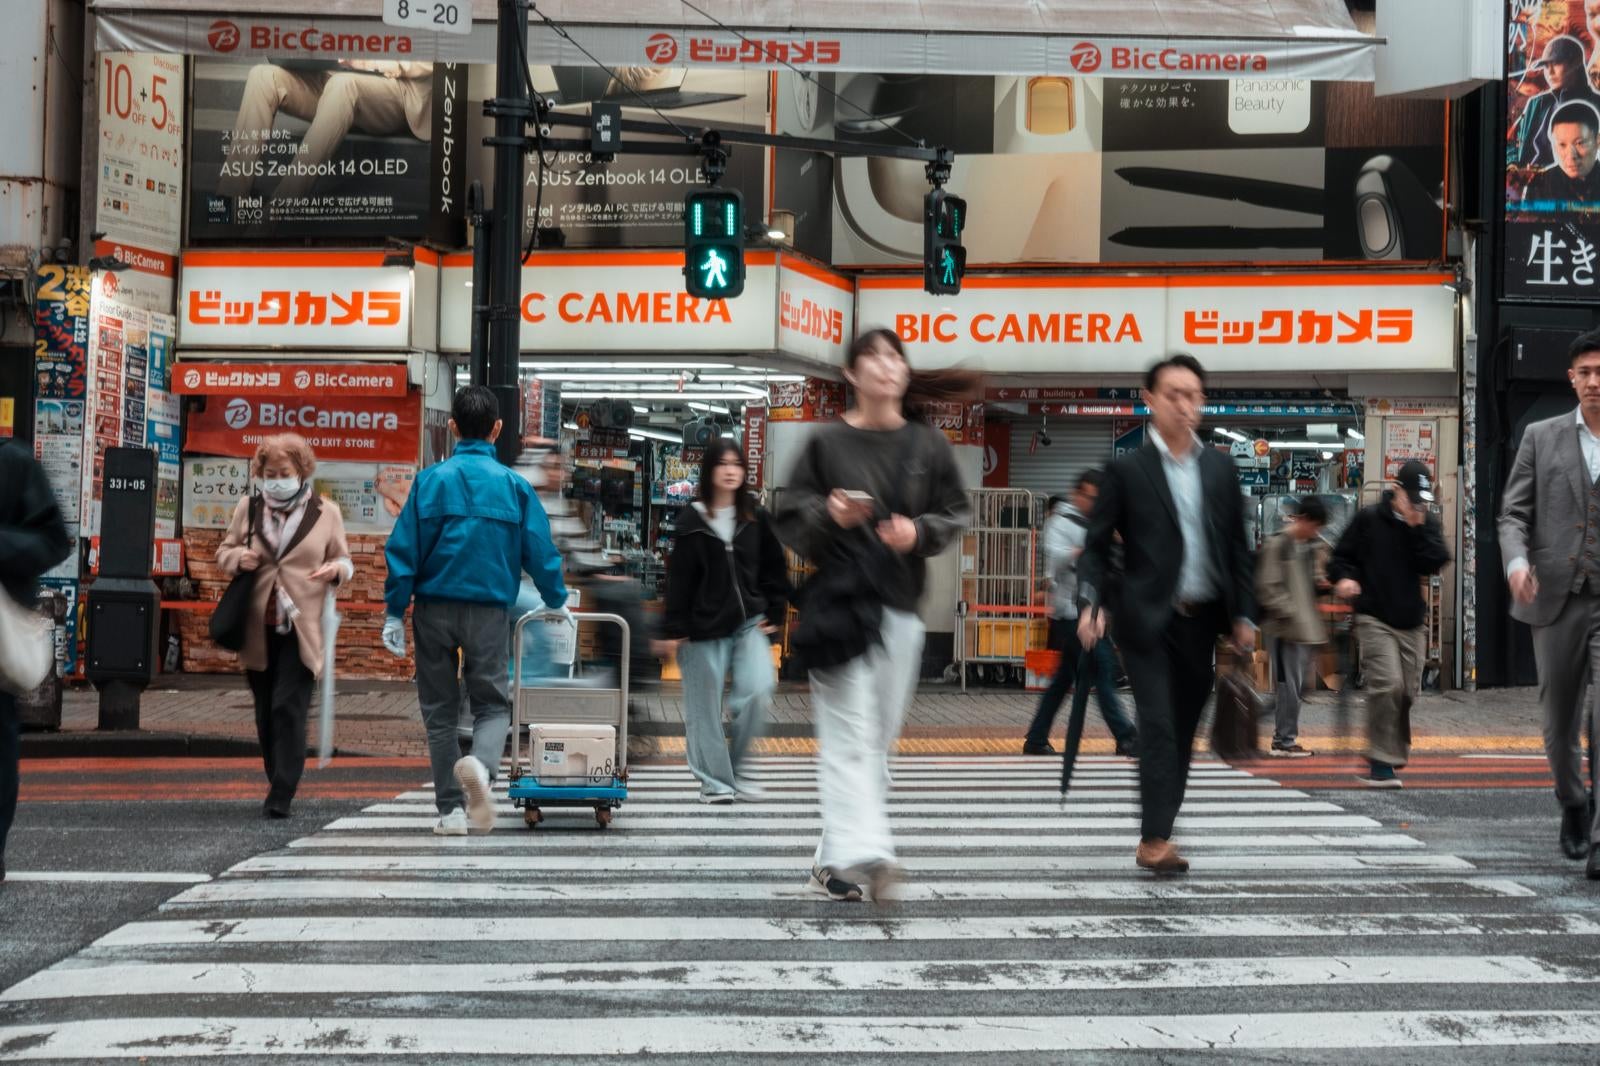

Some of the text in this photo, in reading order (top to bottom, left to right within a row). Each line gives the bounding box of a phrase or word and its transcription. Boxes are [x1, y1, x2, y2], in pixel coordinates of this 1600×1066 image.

[250, 26, 412, 54] BicCamera
[689, 38, 841, 64] ビックカメラ
[1111, 47, 1267, 72] BicCamera
[104, 57, 132, 119] 10
[152, 74, 167, 129] 5
[1235, 79, 1304, 92] Panasonic
[1234, 96, 1286, 114] Beauty
[132, 112, 146, 125] OFF
[441, 76, 456, 214] Zenbook
[220, 158, 409, 177] ASUS Zenbook 14 OLED
[526, 168, 706, 186] ASUS Zenbook 14 OLE
[238, 195, 263, 209] intel
[311, 198, 321, 206] AI
[322, 198, 335, 206] PC
[604, 203, 614, 212] AI
[616, 203, 629, 212] PC
[237, 208, 263, 219] evo
[124, 249, 165, 272] BicCamera
[1525, 229, 1597, 286] 生き
[189, 290, 402, 326] ビックカメラ
[558, 291, 733, 324] CAMERA
[780, 290, 843, 345] ビックカメラ
[1184, 308, 1413, 345] ビックカメラ
[895, 313, 1143, 344] BIC CAMERA
[205, 371, 281, 387] ビックカメラ
[314, 373, 394, 388] BicCamera
[1043, 389, 1076, 399] building
[259, 403, 399, 430] BicCamera
[1082, 405, 1115, 415] building
[321, 440, 341, 448] EXIT
[345, 440, 375, 449] STORE
[109, 478, 146, 490] 331-05
